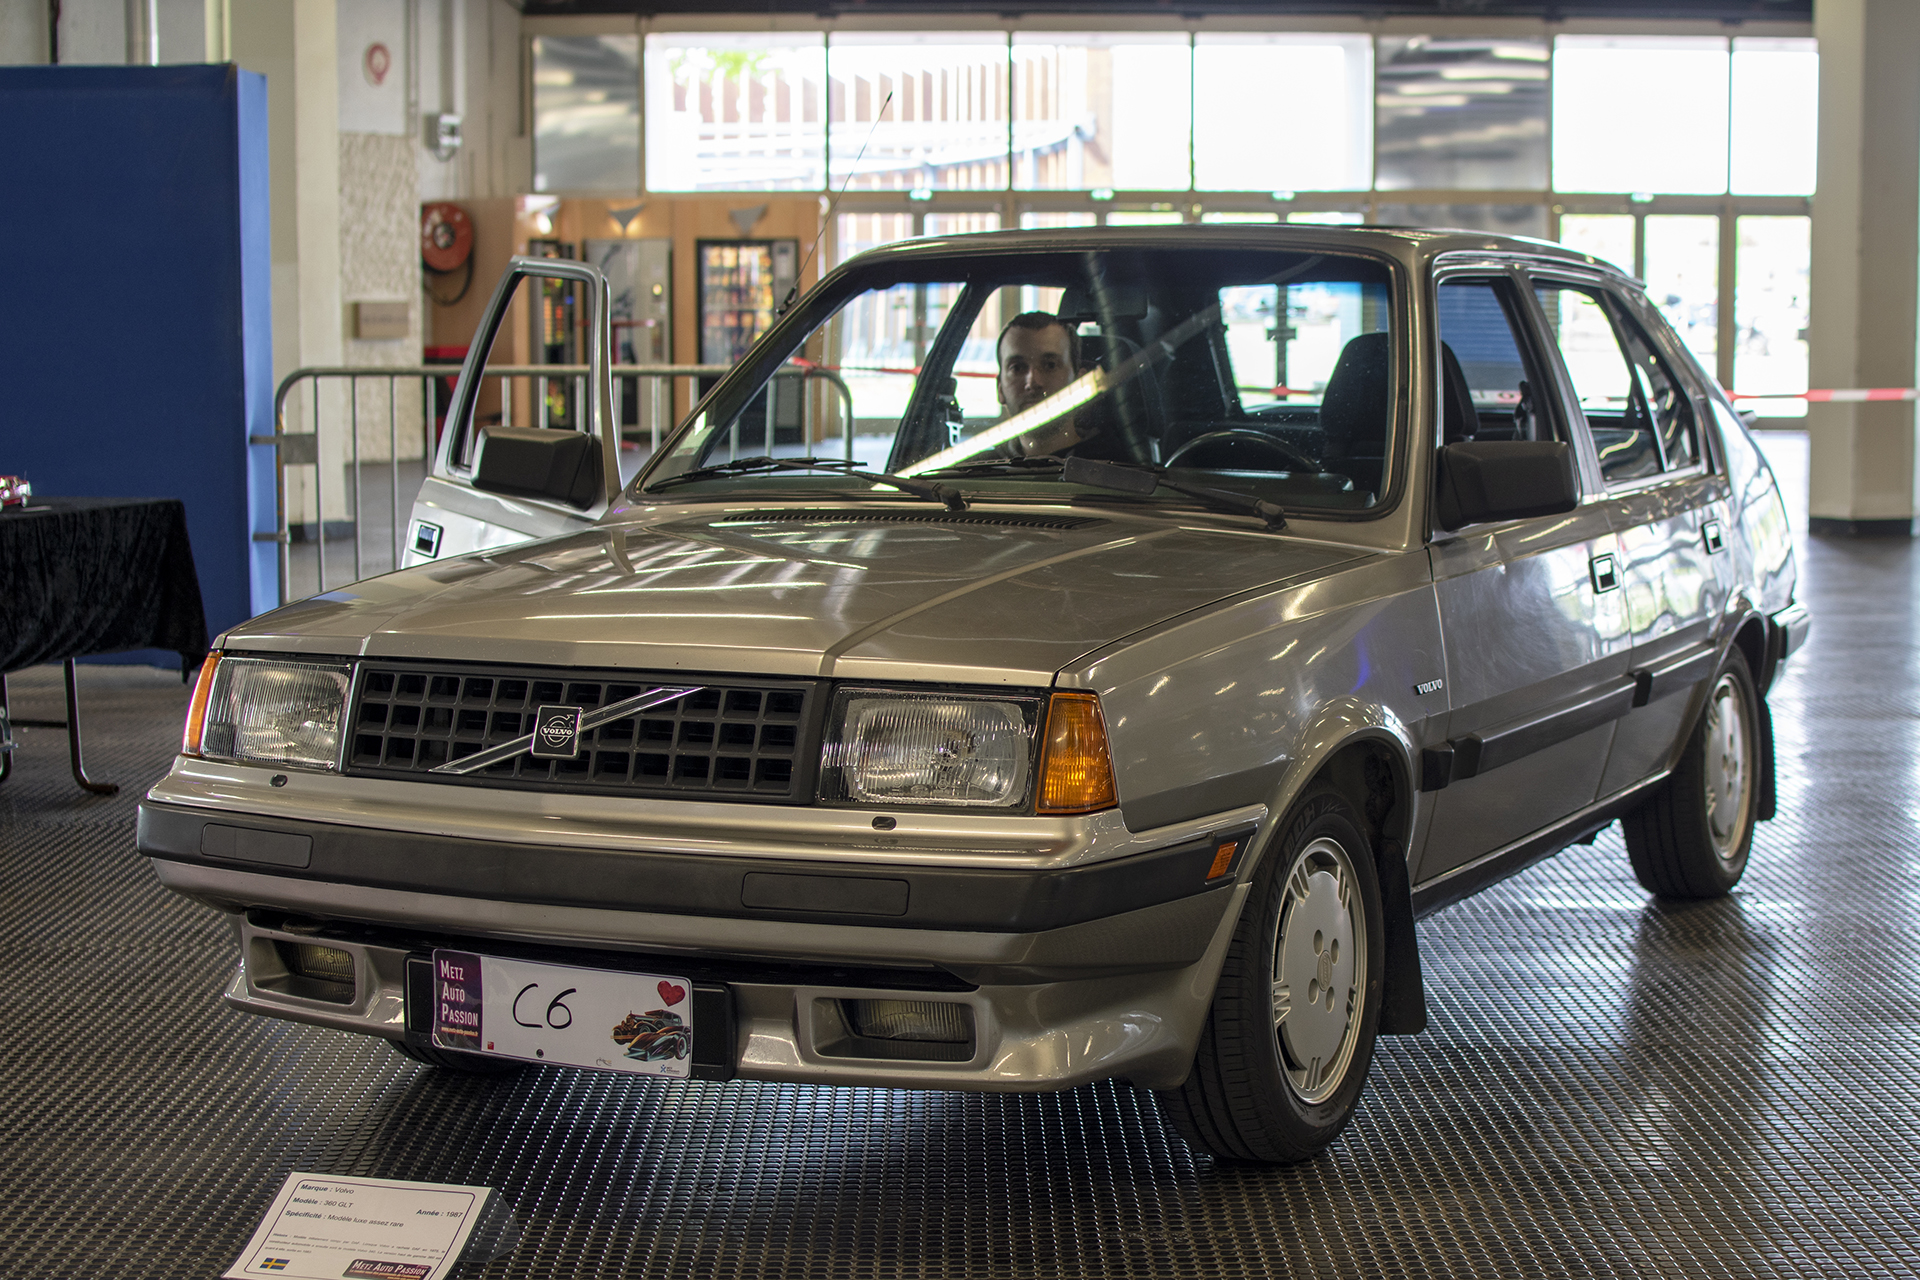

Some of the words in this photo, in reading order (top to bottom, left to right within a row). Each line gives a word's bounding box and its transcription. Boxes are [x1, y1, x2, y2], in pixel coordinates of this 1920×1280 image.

[1416, 678, 1443, 695] VOLVO
[512, 982, 577, 1030] C6
[300, 1184, 328, 1192] Marque
[292, 1197, 319, 1205] Modèle
[285, 1209, 322, 1219] Spécificité
[327, 1214, 352, 1222] Modèle
[368, 1219, 389, 1227] assez
[416, 1208, 440, 1217] Année
